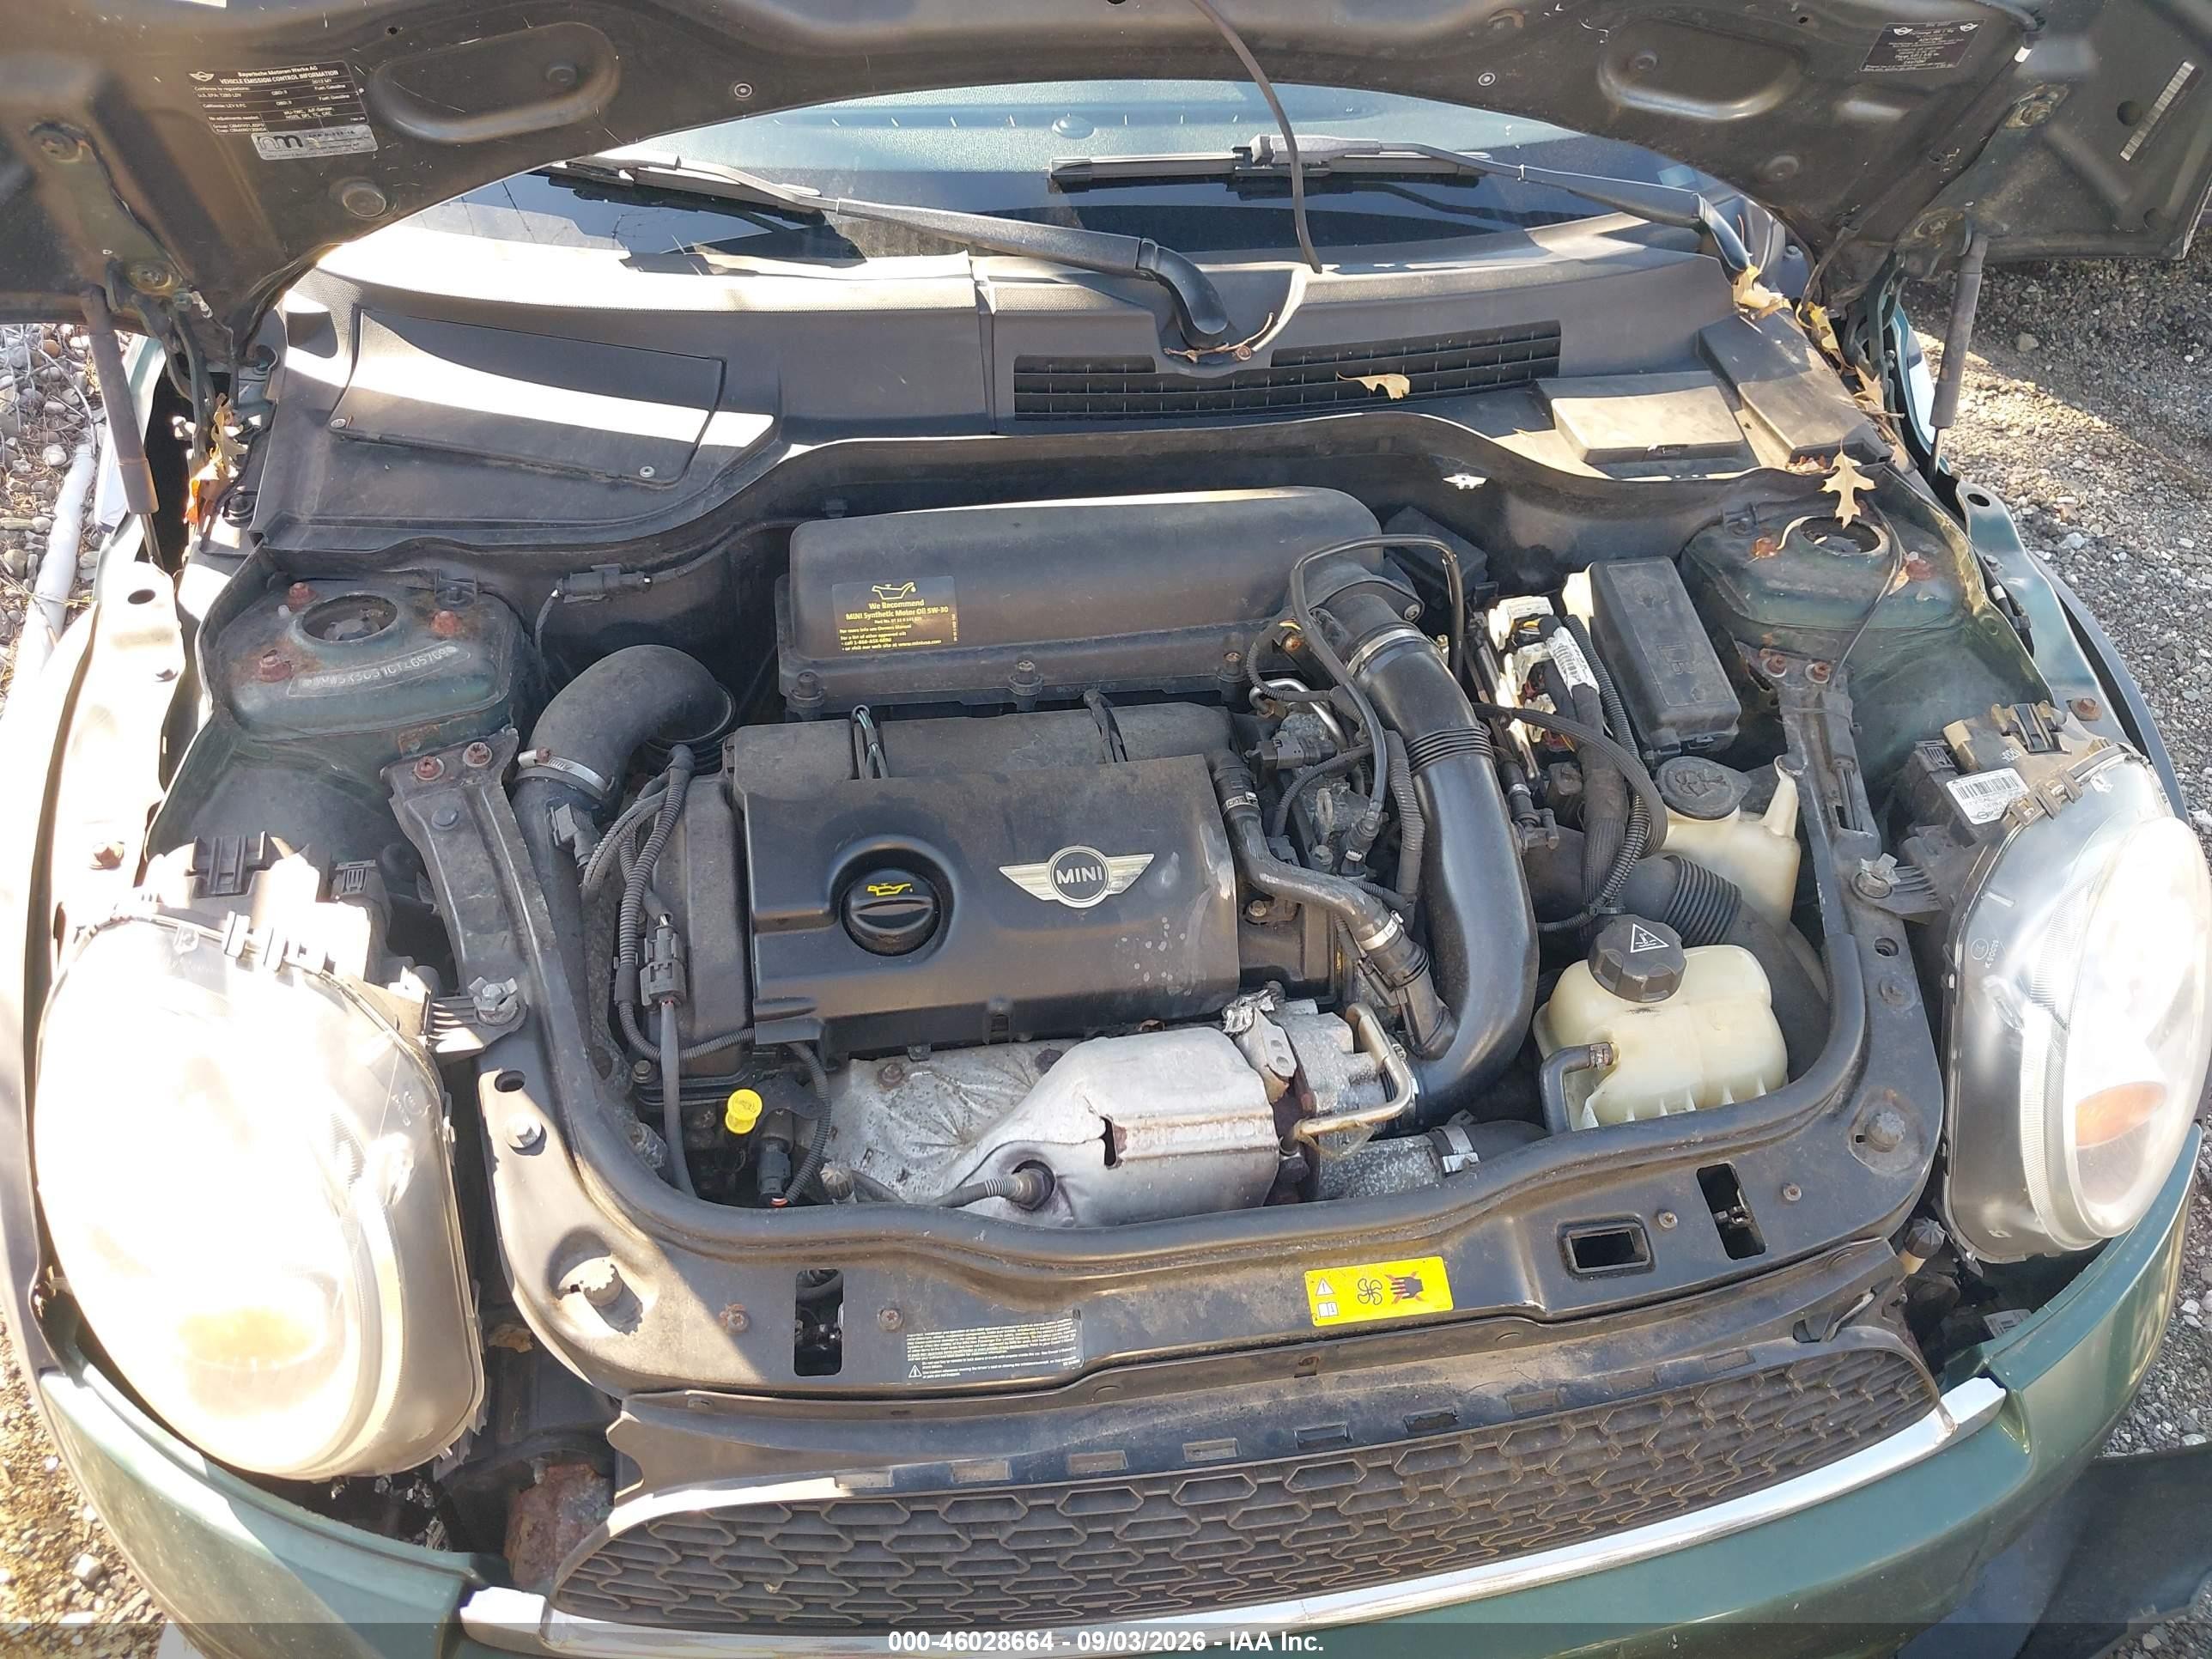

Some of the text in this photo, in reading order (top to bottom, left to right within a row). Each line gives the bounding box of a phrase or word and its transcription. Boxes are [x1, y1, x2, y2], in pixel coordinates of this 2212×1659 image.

[300, 70, 338, 79] INFORMATION
[882, 599, 925, 609] Recommend
[864, 611, 894, 620] Synthetic
[927, 605, 948, 614] 5W-30
[1057, 866, 1103, 884] MINI
